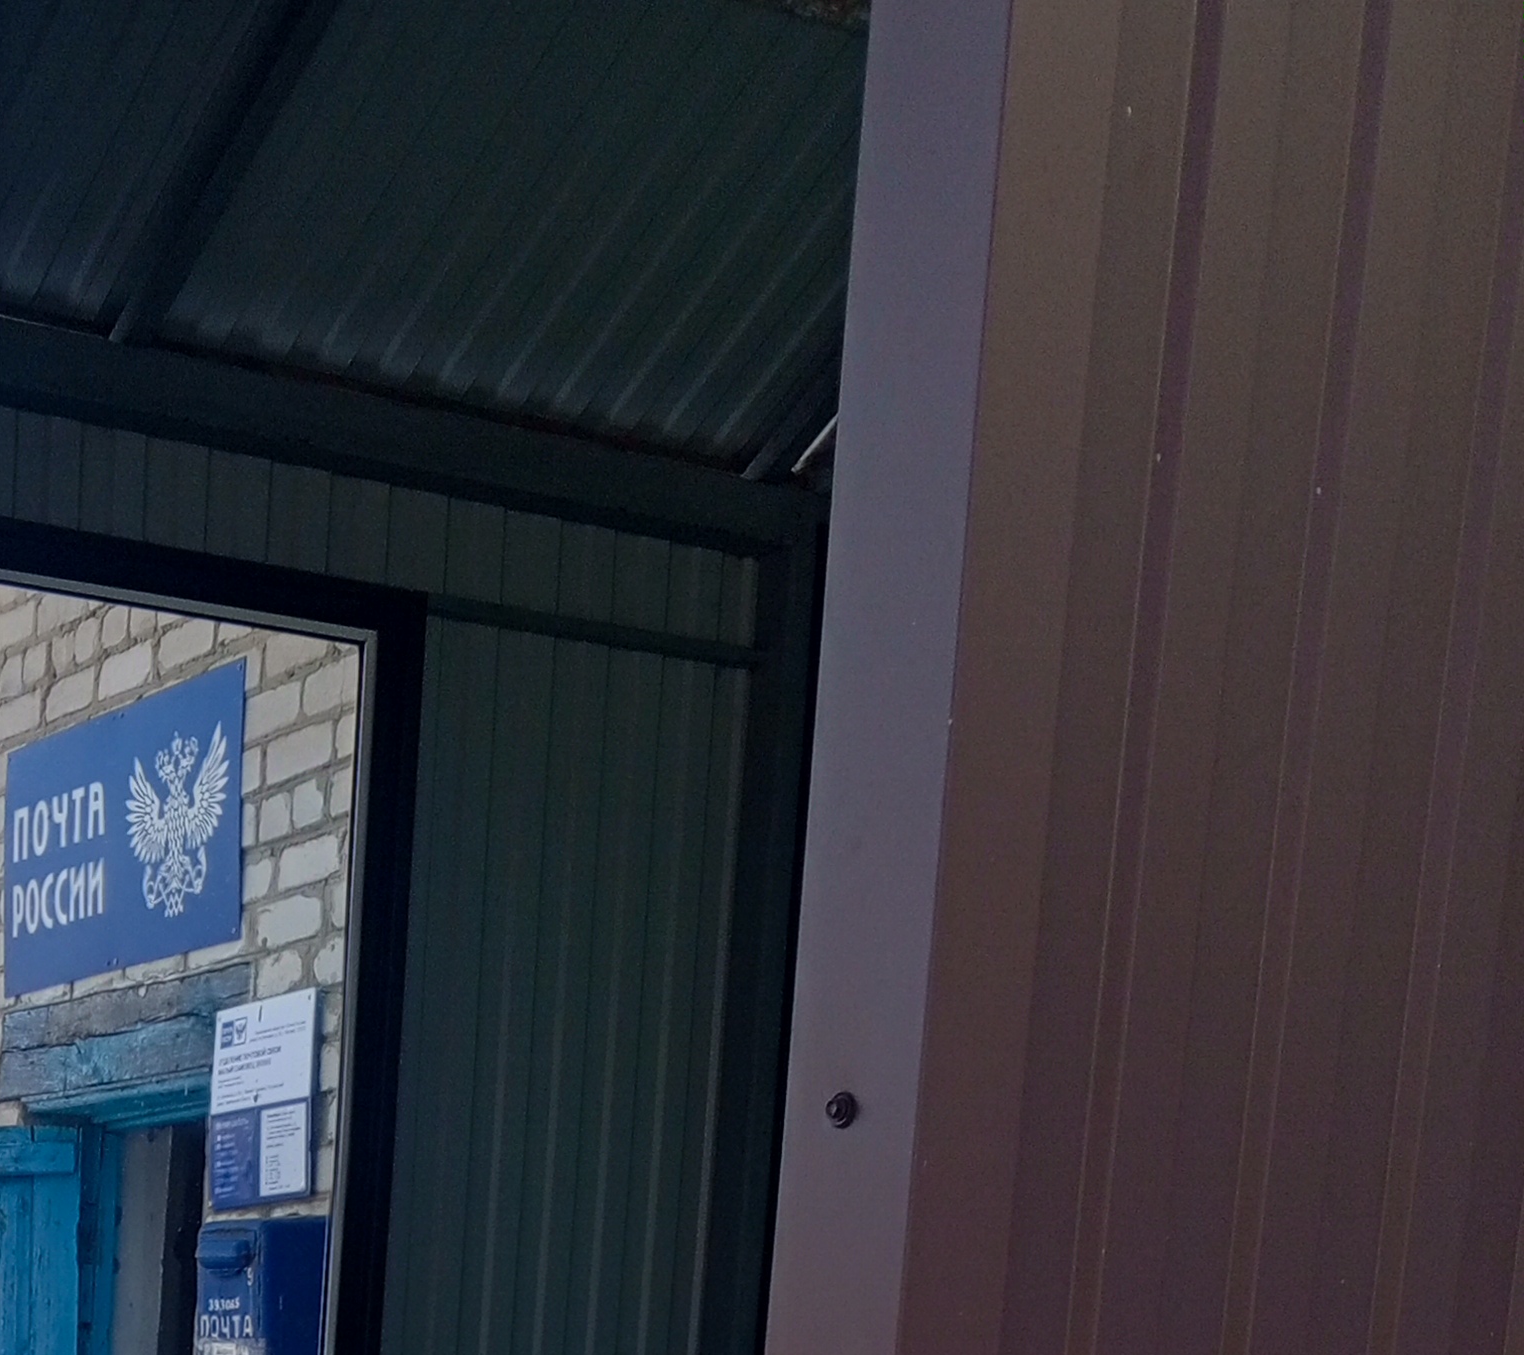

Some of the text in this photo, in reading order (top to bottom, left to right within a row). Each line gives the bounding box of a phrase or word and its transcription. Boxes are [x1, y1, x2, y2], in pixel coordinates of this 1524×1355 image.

[13, 781, 105, 863] ПОЧТА
[12, 857, 104, 938] РОССИИ
[200, 1314, 253, 1339] ПОЧТА
